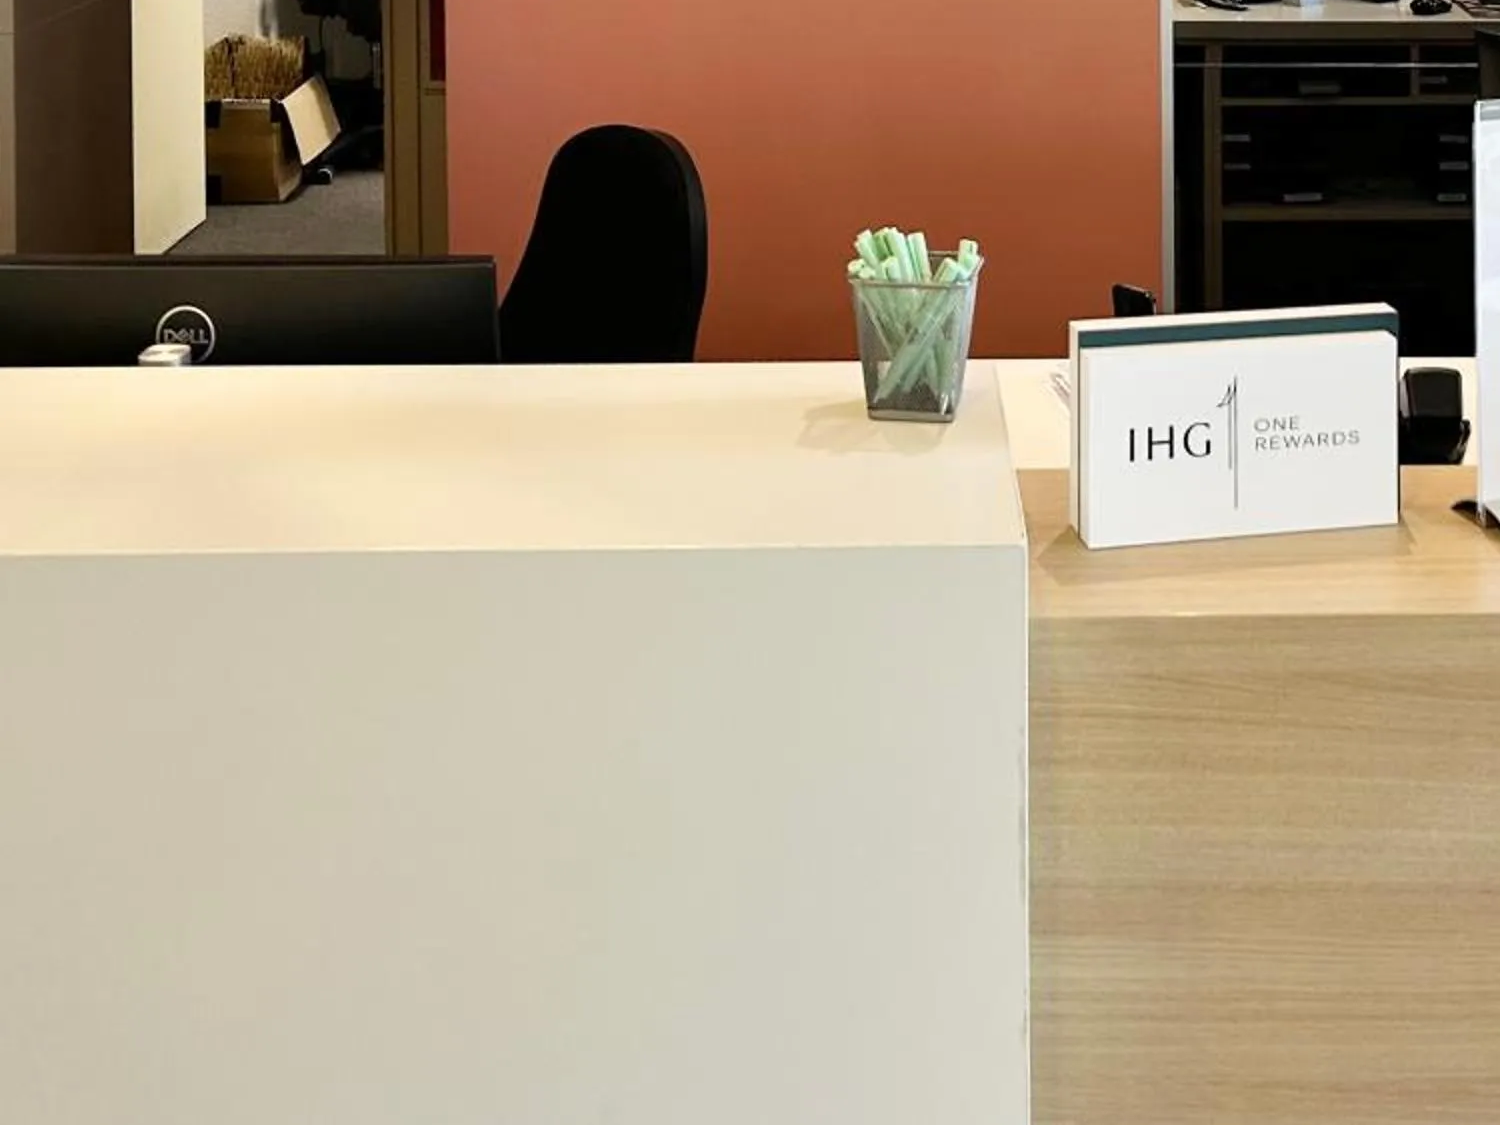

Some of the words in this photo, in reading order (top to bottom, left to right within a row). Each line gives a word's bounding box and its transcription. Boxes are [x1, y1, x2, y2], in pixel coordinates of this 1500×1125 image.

[163, 327, 209, 344] DELL
[1253, 415, 1300, 433] ONE
[1129, 421, 1212, 463] IHG
[1254, 430, 1361, 452] REWARDS
